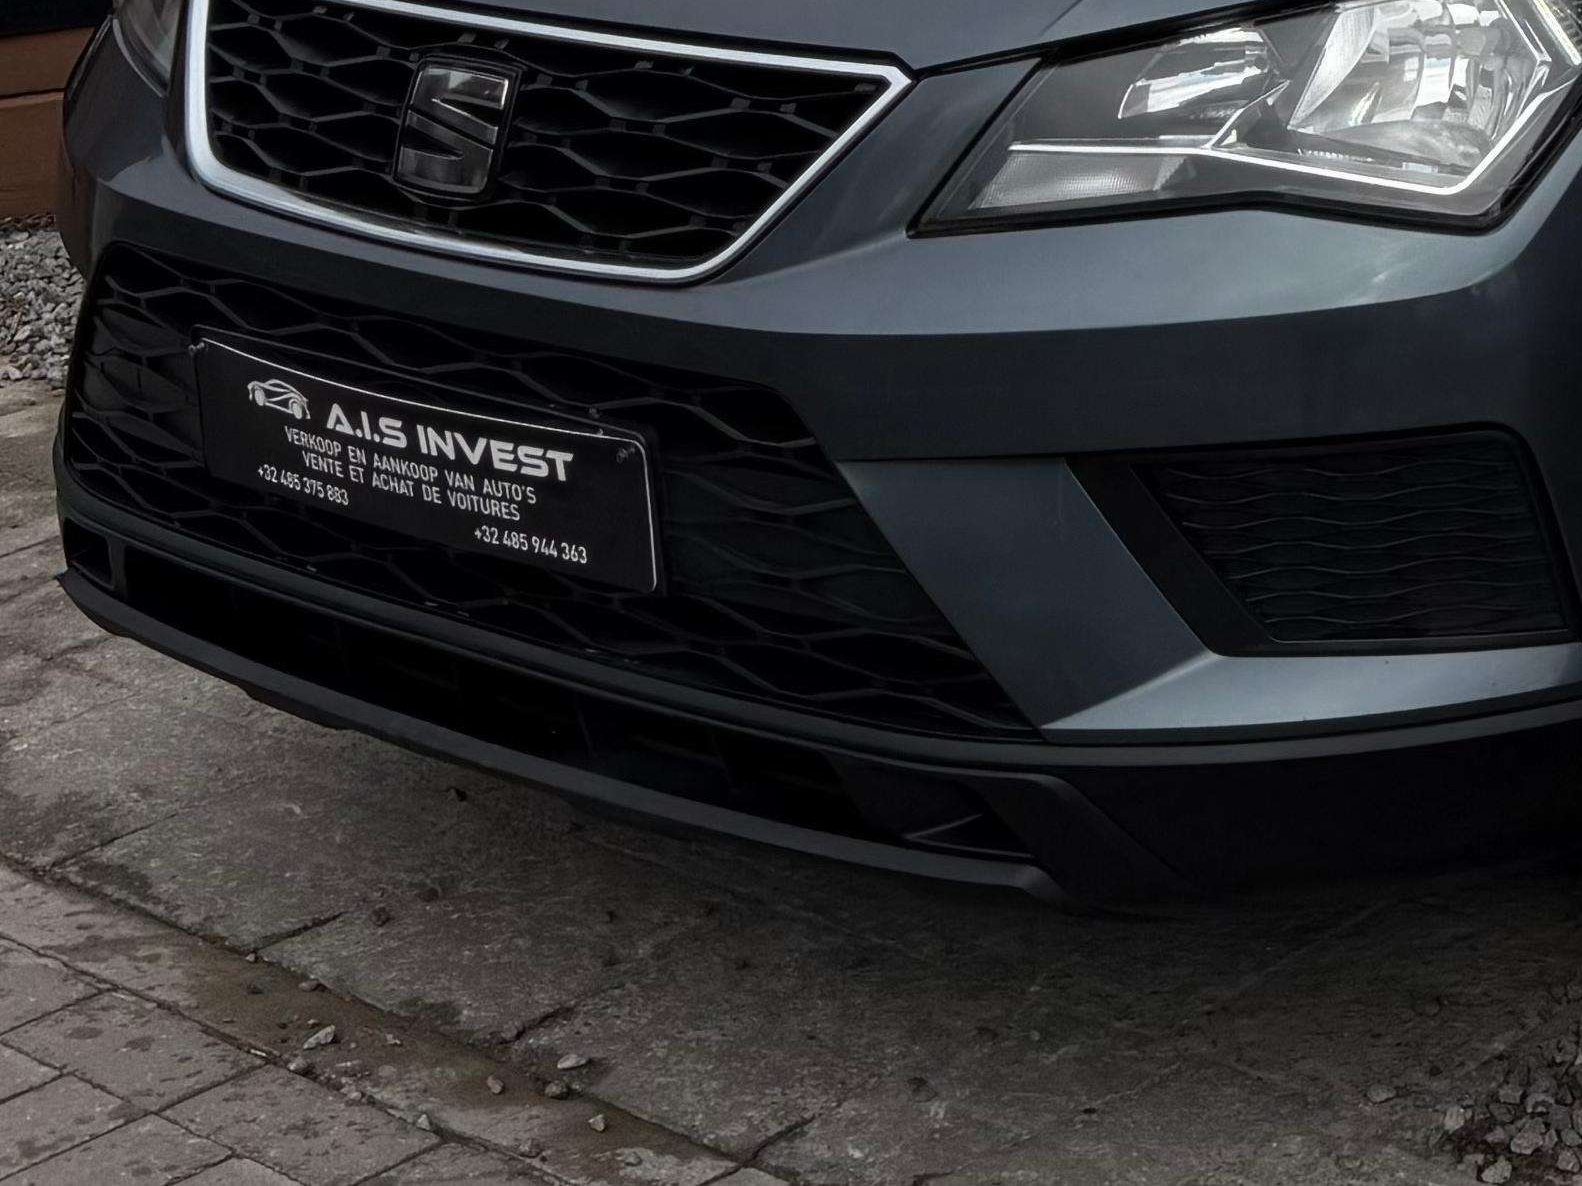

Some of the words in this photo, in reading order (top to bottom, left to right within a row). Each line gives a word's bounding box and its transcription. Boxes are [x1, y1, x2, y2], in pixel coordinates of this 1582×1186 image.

[284, 426, 342, 457] VERKOOP
[347, 445, 368, 467] EN
[373, 453, 439, 483] AANKOOP
[444, 470, 476, 493] VAN
[482, 479, 537, 505] AUTO'S
[326, 402, 408, 450] A.I.S
[416, 424, 575, 482] INVEST
[302, 450, 344, 478] VENTE
[350, 465, 366, 485] ET
[371, 471, 414, 497] ACHAT
[422, 485, 443, 505] DE
[448, 491, 521, 522] VOITURES
[302, 478, 325, 499] 375
[473, 525, 500, 546] +32
[501, 531, 528, 550] 485
[532, 537, 557, 557] 944
[560, 543, 587, 564] 363
